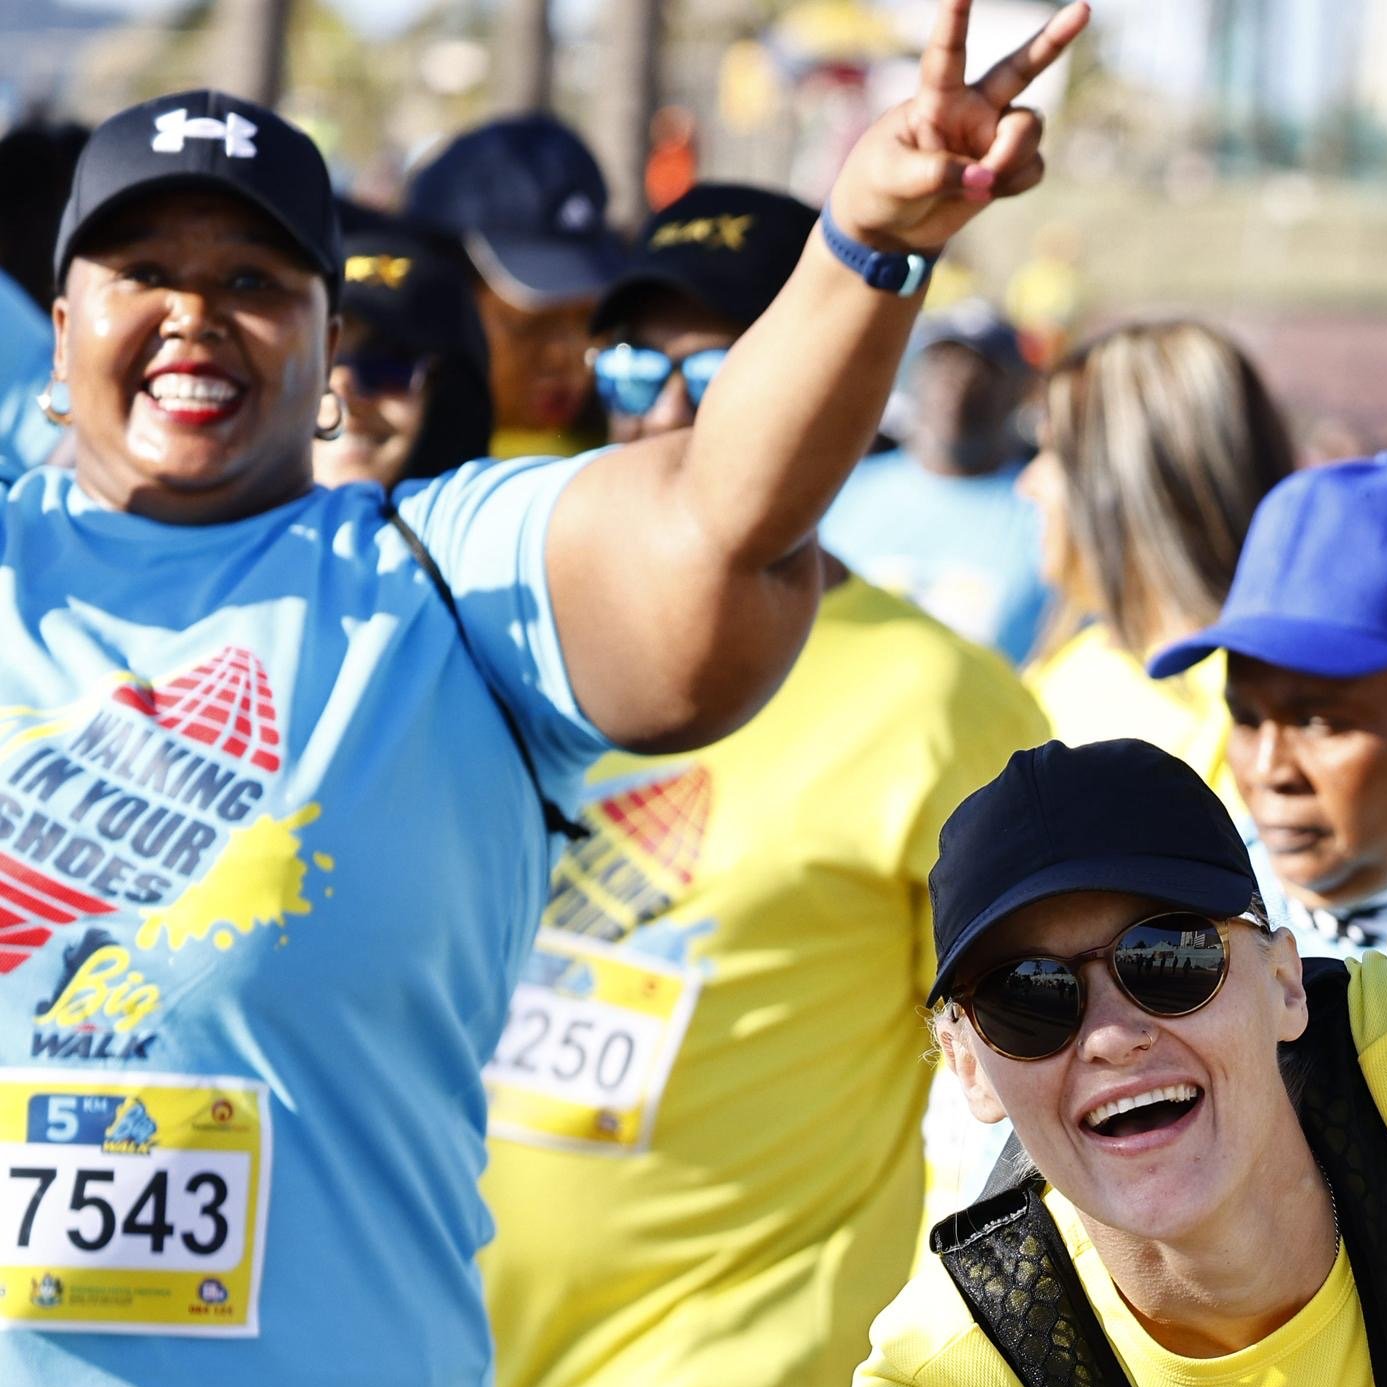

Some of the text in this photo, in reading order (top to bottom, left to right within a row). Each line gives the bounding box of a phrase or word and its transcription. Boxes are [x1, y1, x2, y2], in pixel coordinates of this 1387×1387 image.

[70, 710, 264, 822] WALKING
[0, 793, 173, 904] SHOES
[8, 747, 217, 877] IN YOUR
[33, 944, 161, 1034] Big
[31, 1033, 158, 1059] WALK
[492, 1011, 635, 1092] 250
[46, 1097, 108, 1142] 5 KM
[9, 1167, 229, 1256] 7543
